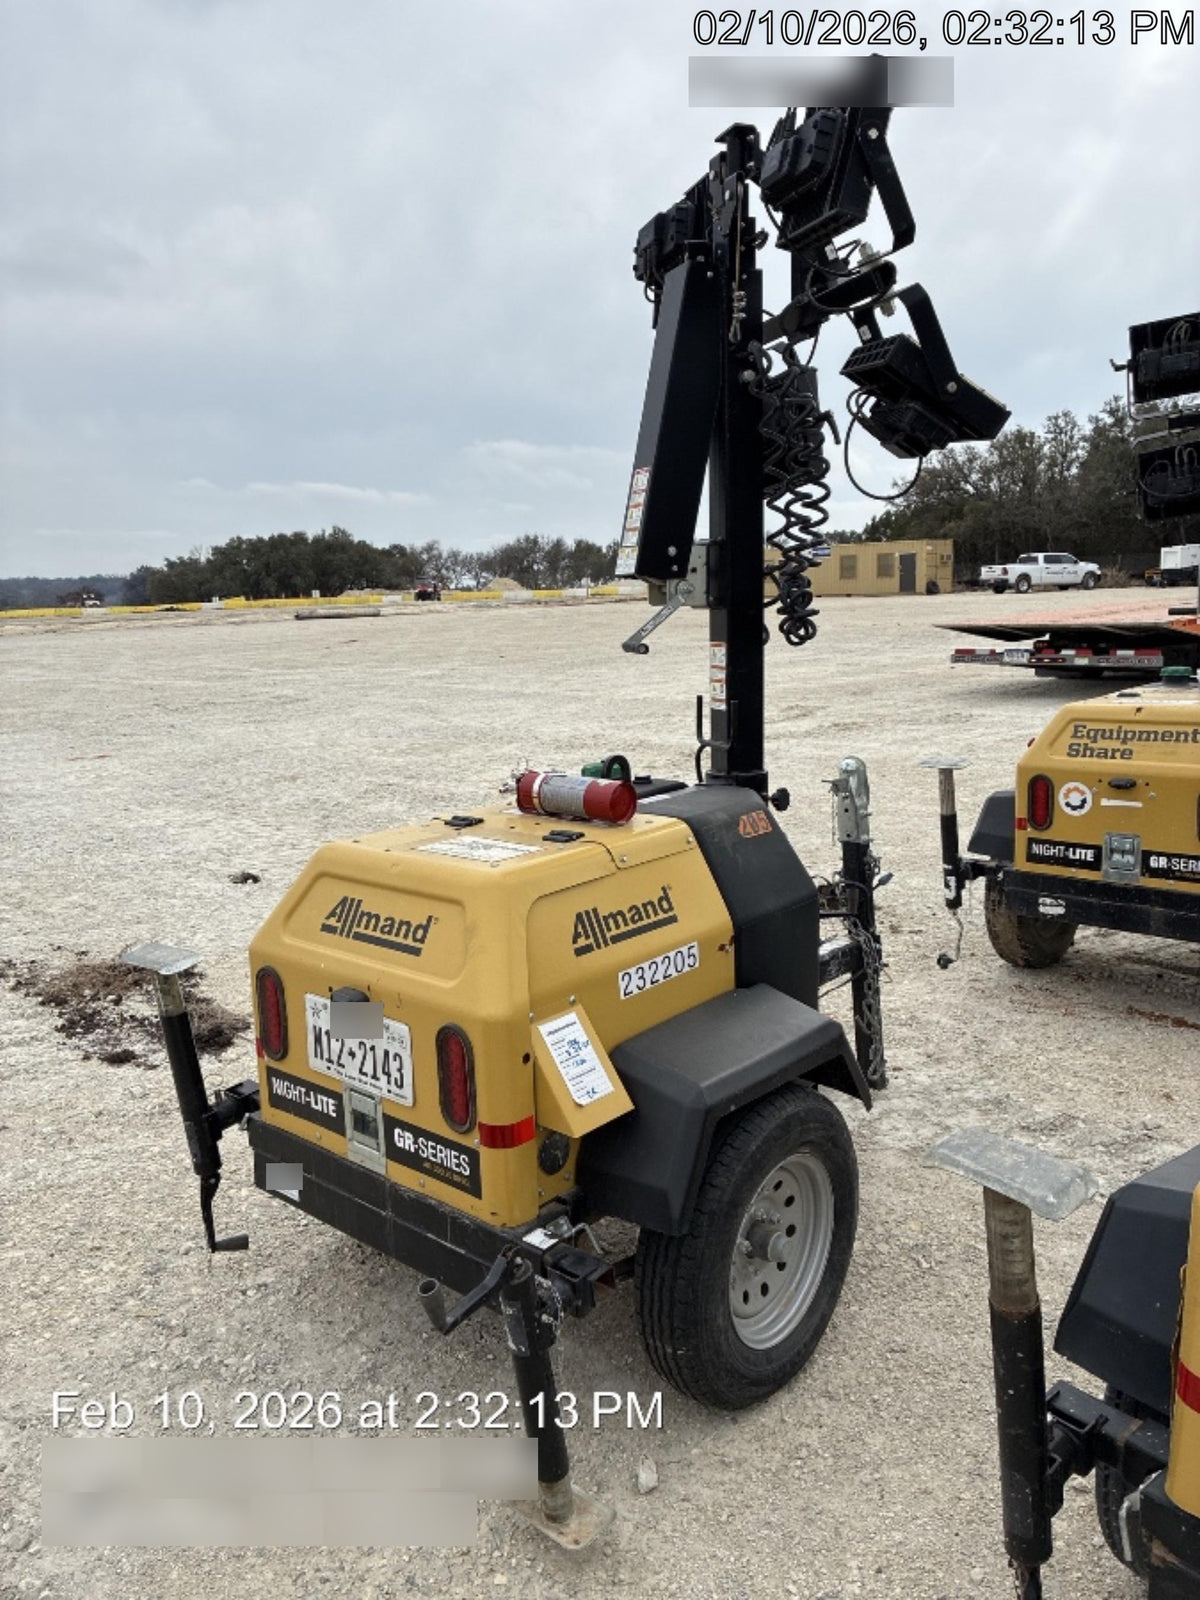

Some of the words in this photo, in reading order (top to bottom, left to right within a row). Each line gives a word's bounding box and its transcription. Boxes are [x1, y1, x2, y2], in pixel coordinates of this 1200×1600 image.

[1066, 742, 1134, 760] Share
[1069, 724, 1200, 745] Equipment
[1031, 843, 1095, 862] NIGHT-LITE
[324, 896, 434, 945] Allmand
[571, 884, 676, 951] Allmand
[620, 944, 698, 997] 232205
[271, 1076, 337, 1118] NIGHT-LITE
[393, 1127, 471, 1177] GR-SERIES
